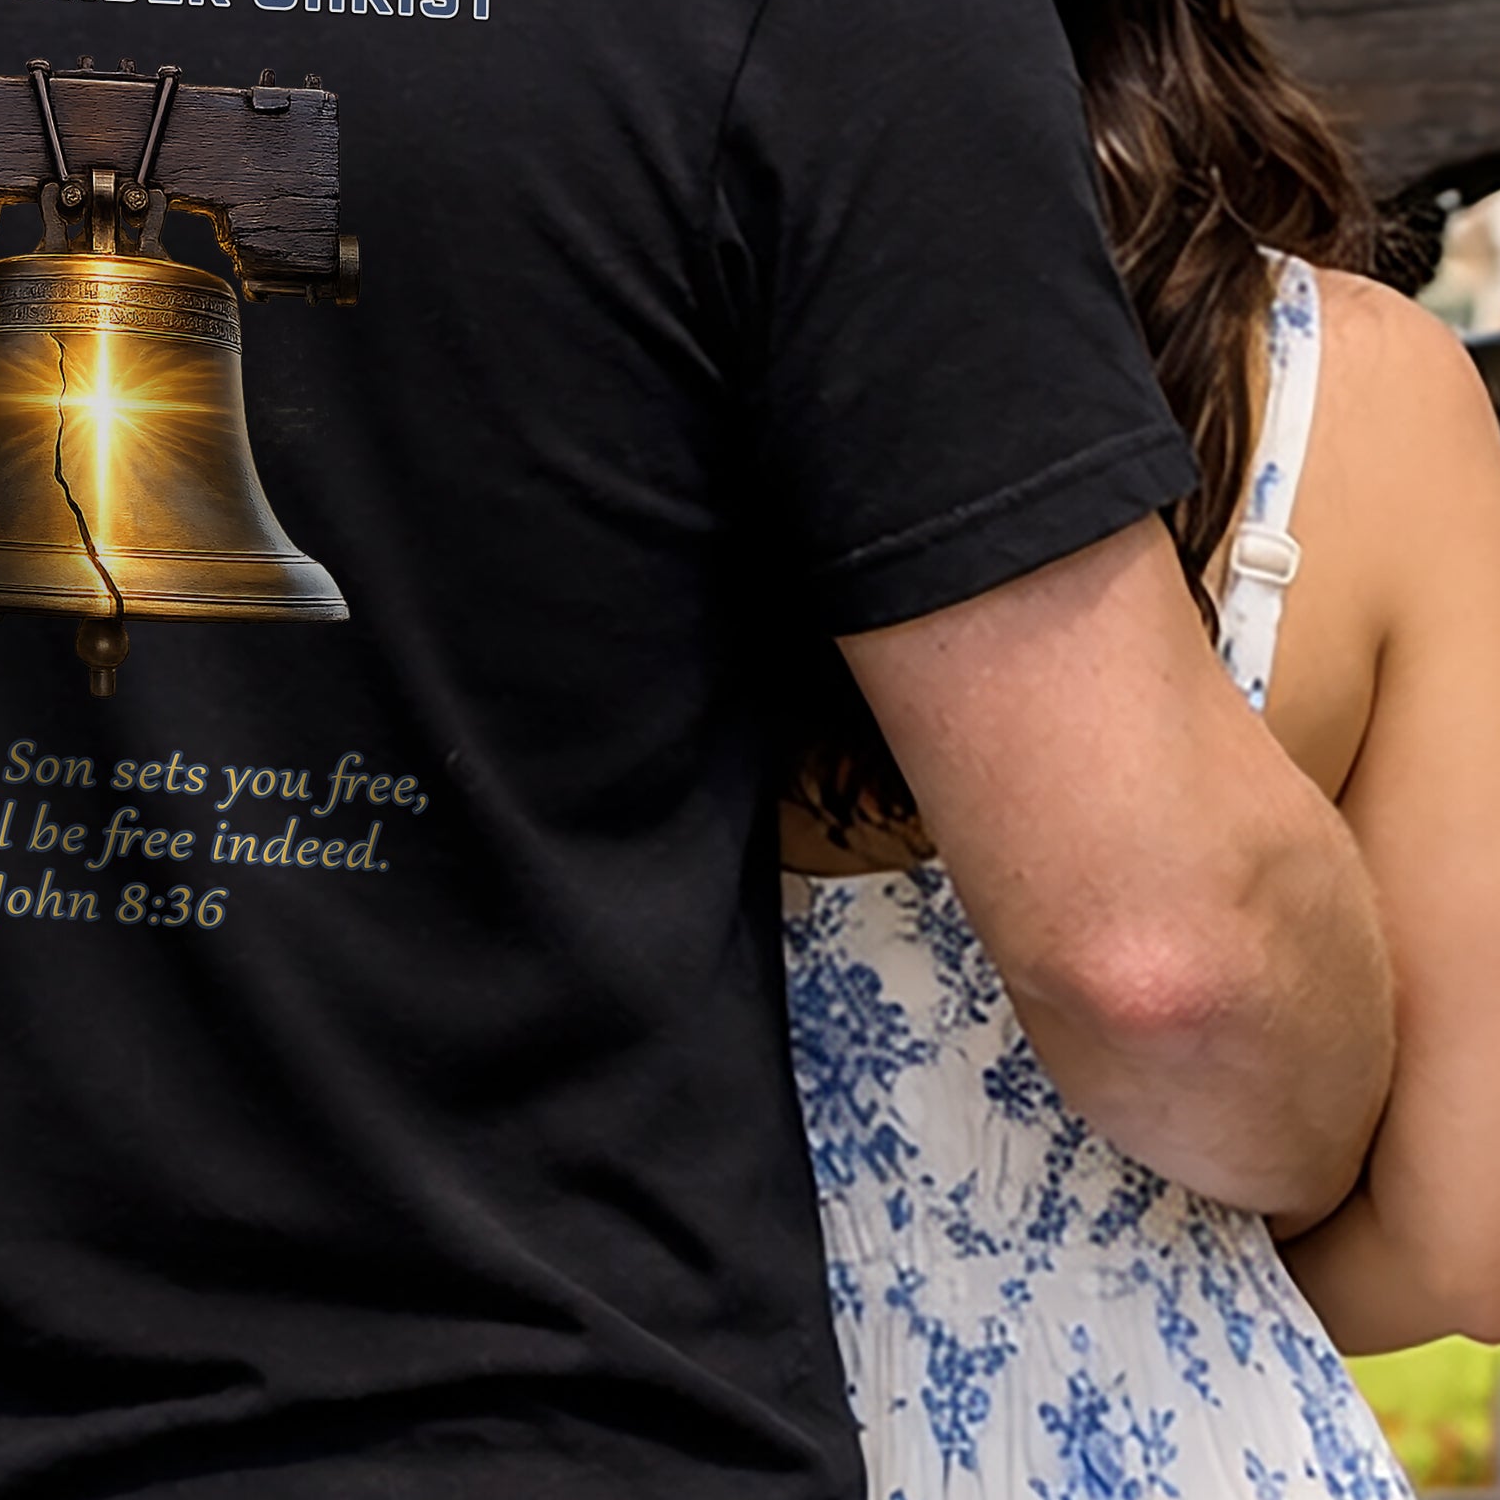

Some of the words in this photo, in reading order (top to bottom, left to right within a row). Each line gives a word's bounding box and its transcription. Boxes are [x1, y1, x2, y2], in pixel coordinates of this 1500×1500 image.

[2, 739, 96, 788] Son
[110, 750, 208, 793] sets
[214, 765, 311, 812] you
[310, 752, 429, 817] free,
[26, 802, 88, 853] be
[85, 807, 196, 871] free
[210, 816, 390, 872] indeed.
[115, 883, 230, 929] 8:36
